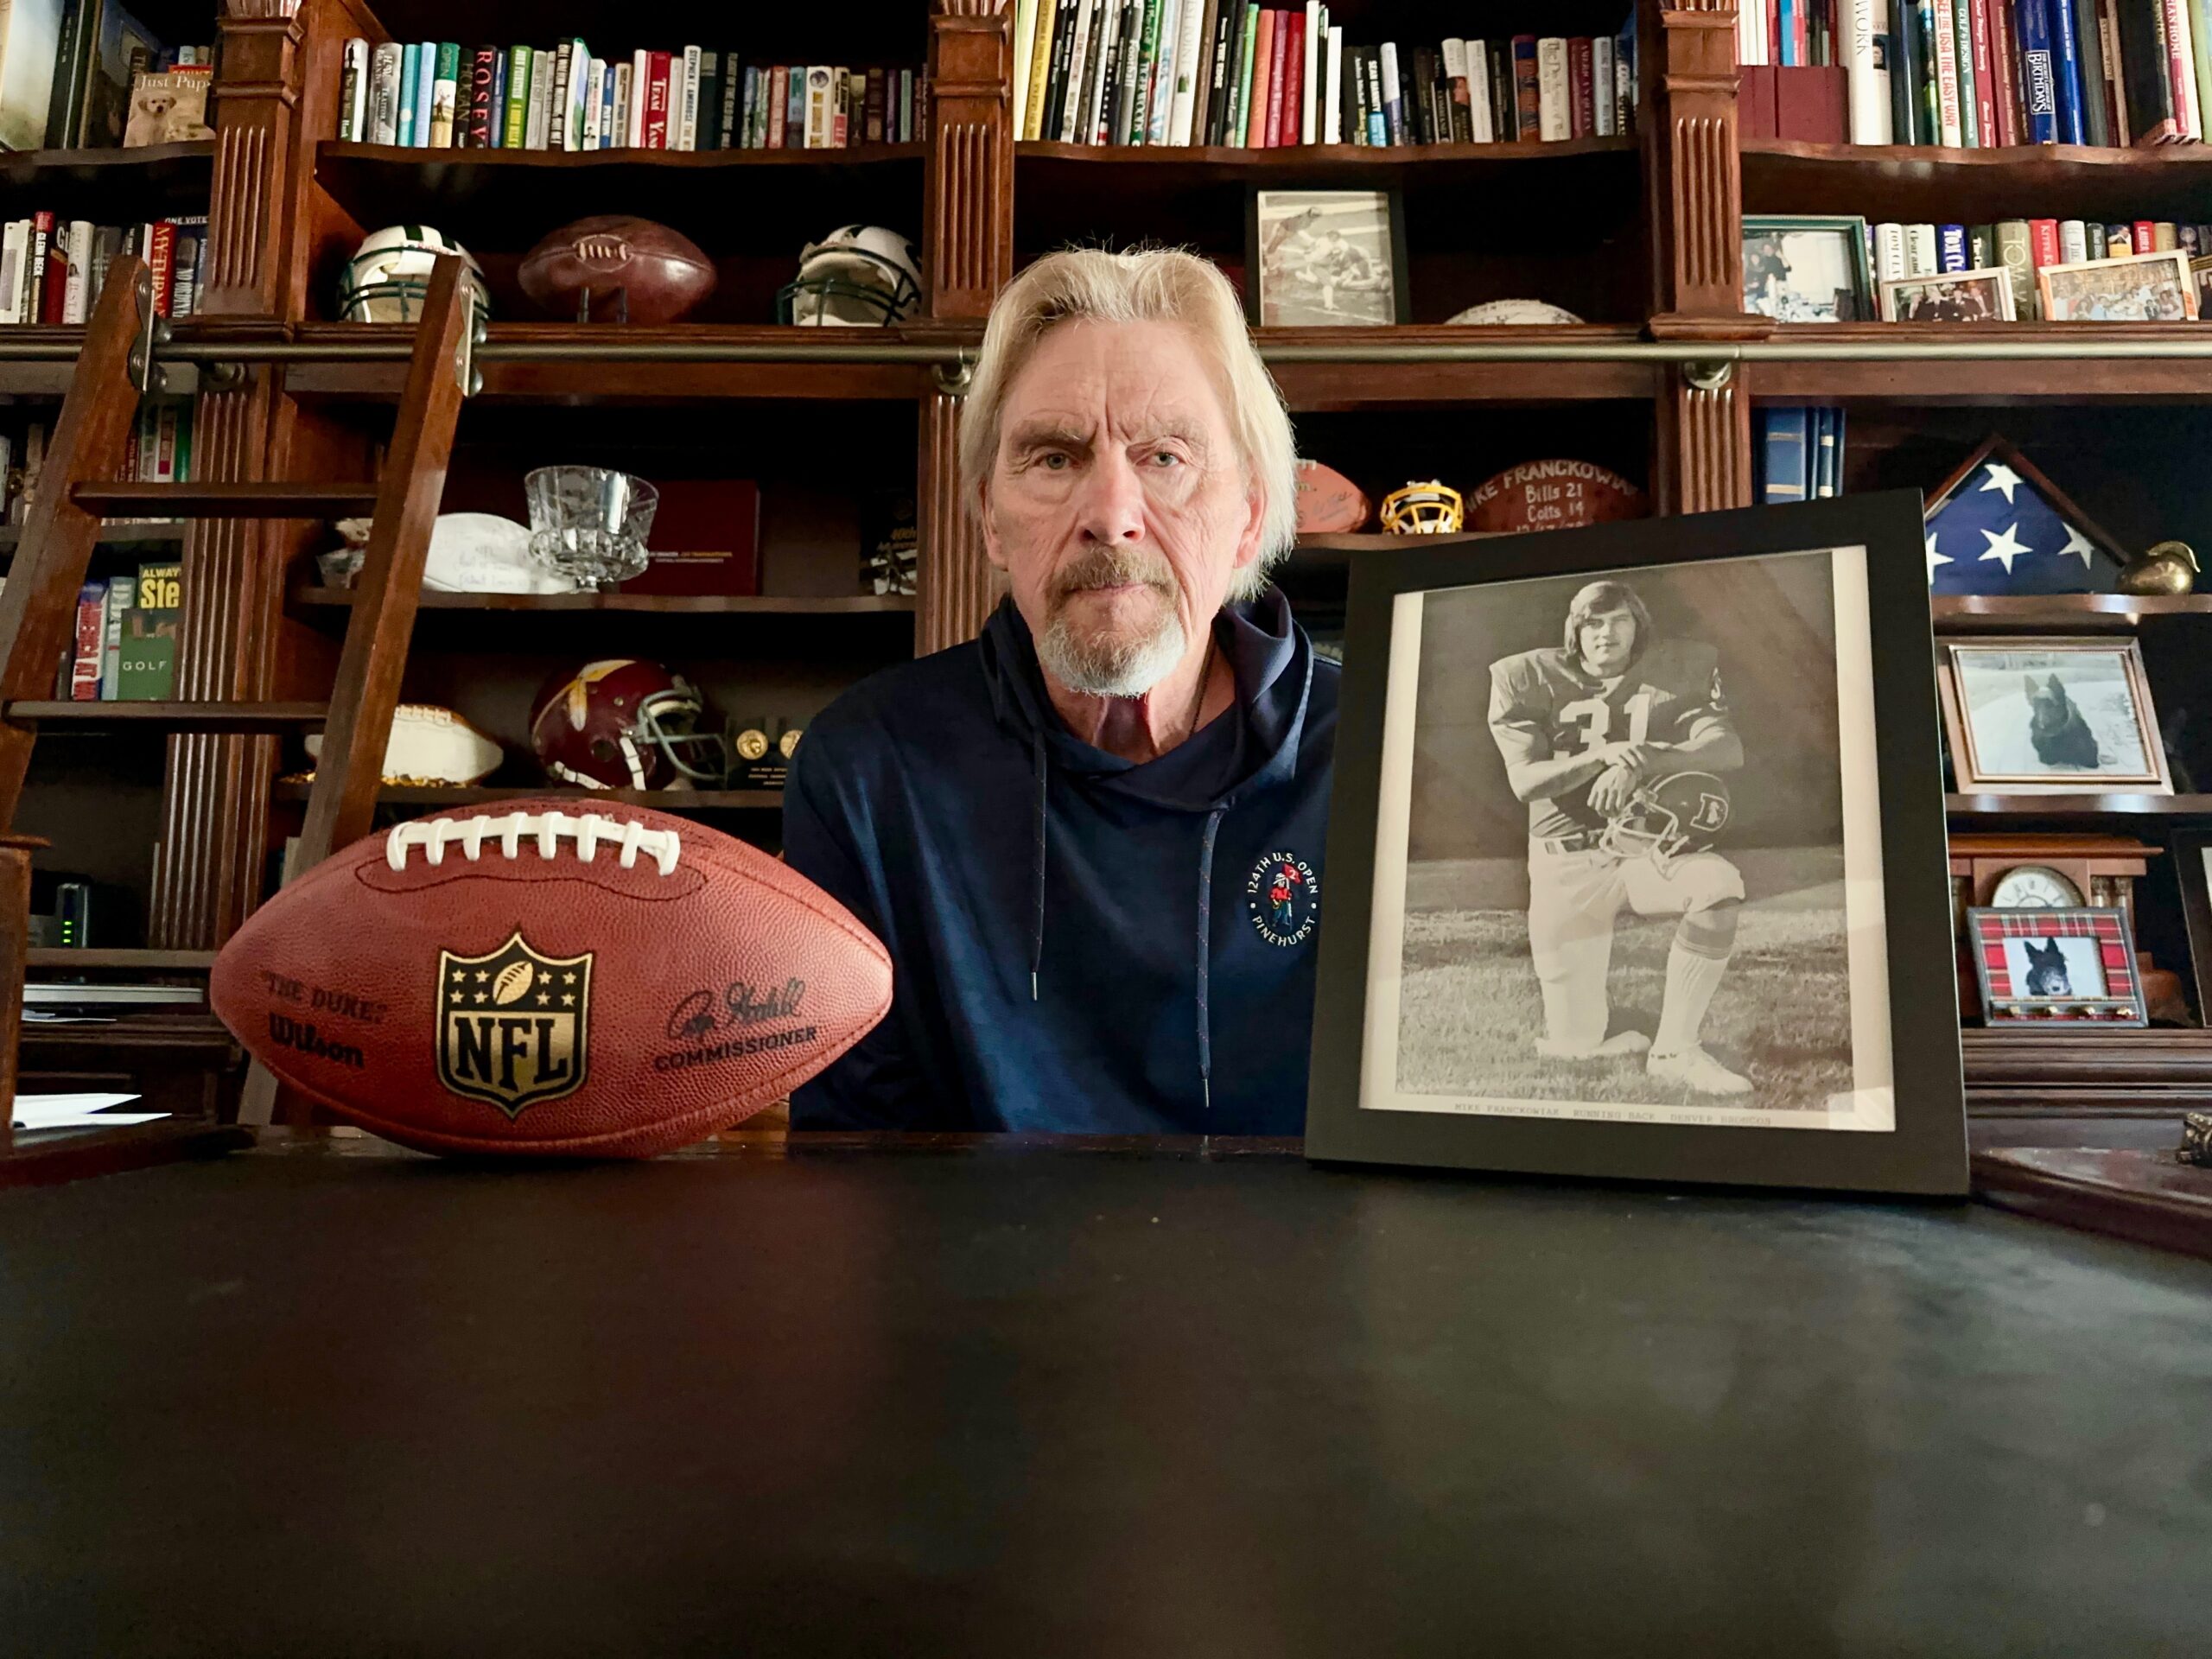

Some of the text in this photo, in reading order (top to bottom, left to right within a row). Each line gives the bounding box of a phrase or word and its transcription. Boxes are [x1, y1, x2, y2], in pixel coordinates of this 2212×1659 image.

[1143, 26, 1153, 45] Golf
[1855, 0, 1870, 55] WORK
[1939, 16, 1950, 30] THE
[1958, 8, 1967, 33] GOLF
[1940, 32, 1952, 53] USA
[1961, 40, 1971, 73] DESIGN
[2170, 26, 2181, 60] HOME
[441, 47, 452, 77] OPEN
[688, 49, 698, 79] STEPHEN
[1124, 39, 1139, 87] Football
[1138, 62, 1150, 92] TIGER
[1942, 56, 1954, 74] THE
[136, 75, 211, 92] Just Pup
[457, 63, 474, 122] HOGAN
[472, 51, 493, 140] ROSEY
[1369, 60, 1381, 112] SEAN HANNITY
[1943, 76, 1956, 103] EASY
[2028, 54, 2047, 112] BIRTHDAYS
[648, 78, 667, 149] TEAM YAN
[1134, 92, 1147, 132] WOODS
[1944, 105, 1957, 128] WAY
[185, 215, 208, 225] VOTE
[34, 232, 47, 276] GLENN BECK
[155, 227, 169, 253] MY
[1909, 230, 1921, 274] Clear and
[1944, 230, 1964, 253] TOM
[2093, 229, 2104, 260] Blue Bloo
[2138, 226, 2151, 251] LAURA
[2003, 238, 2027, 283] TOM
[172, 282, 194, 318] ORDINA
[1525, 482, 1583, 504] Bills 21
[1527, 500, 1585, 523] Colts 14
[142, 568, 181, 578] ALWAY
[140, 578, 181, 609] Ste
[123, 660, 168, 671] GOLF
[1554, 693, 1651, 760] 31
[1247, 852, 1319, 894] 124TH U.S. OPEN
[1251, 915, 1316, 947] PINEHURST
[270, 1011, 365, 1071] Wilson
[454, 1016, 568, 1093] NFL
[653, 1026, 818, 1071] COMMISSIONER
[1454, 1103, 1480, 1112] MIKE
[1486, 1104, 1560, 1116] FRANCKOWIAK
[1573, 1109, 1622, 1120] RUNNING
[1628, 1110, 1656, 1122] BACK
[1669, 1113, 1713, 1123] DENVER
